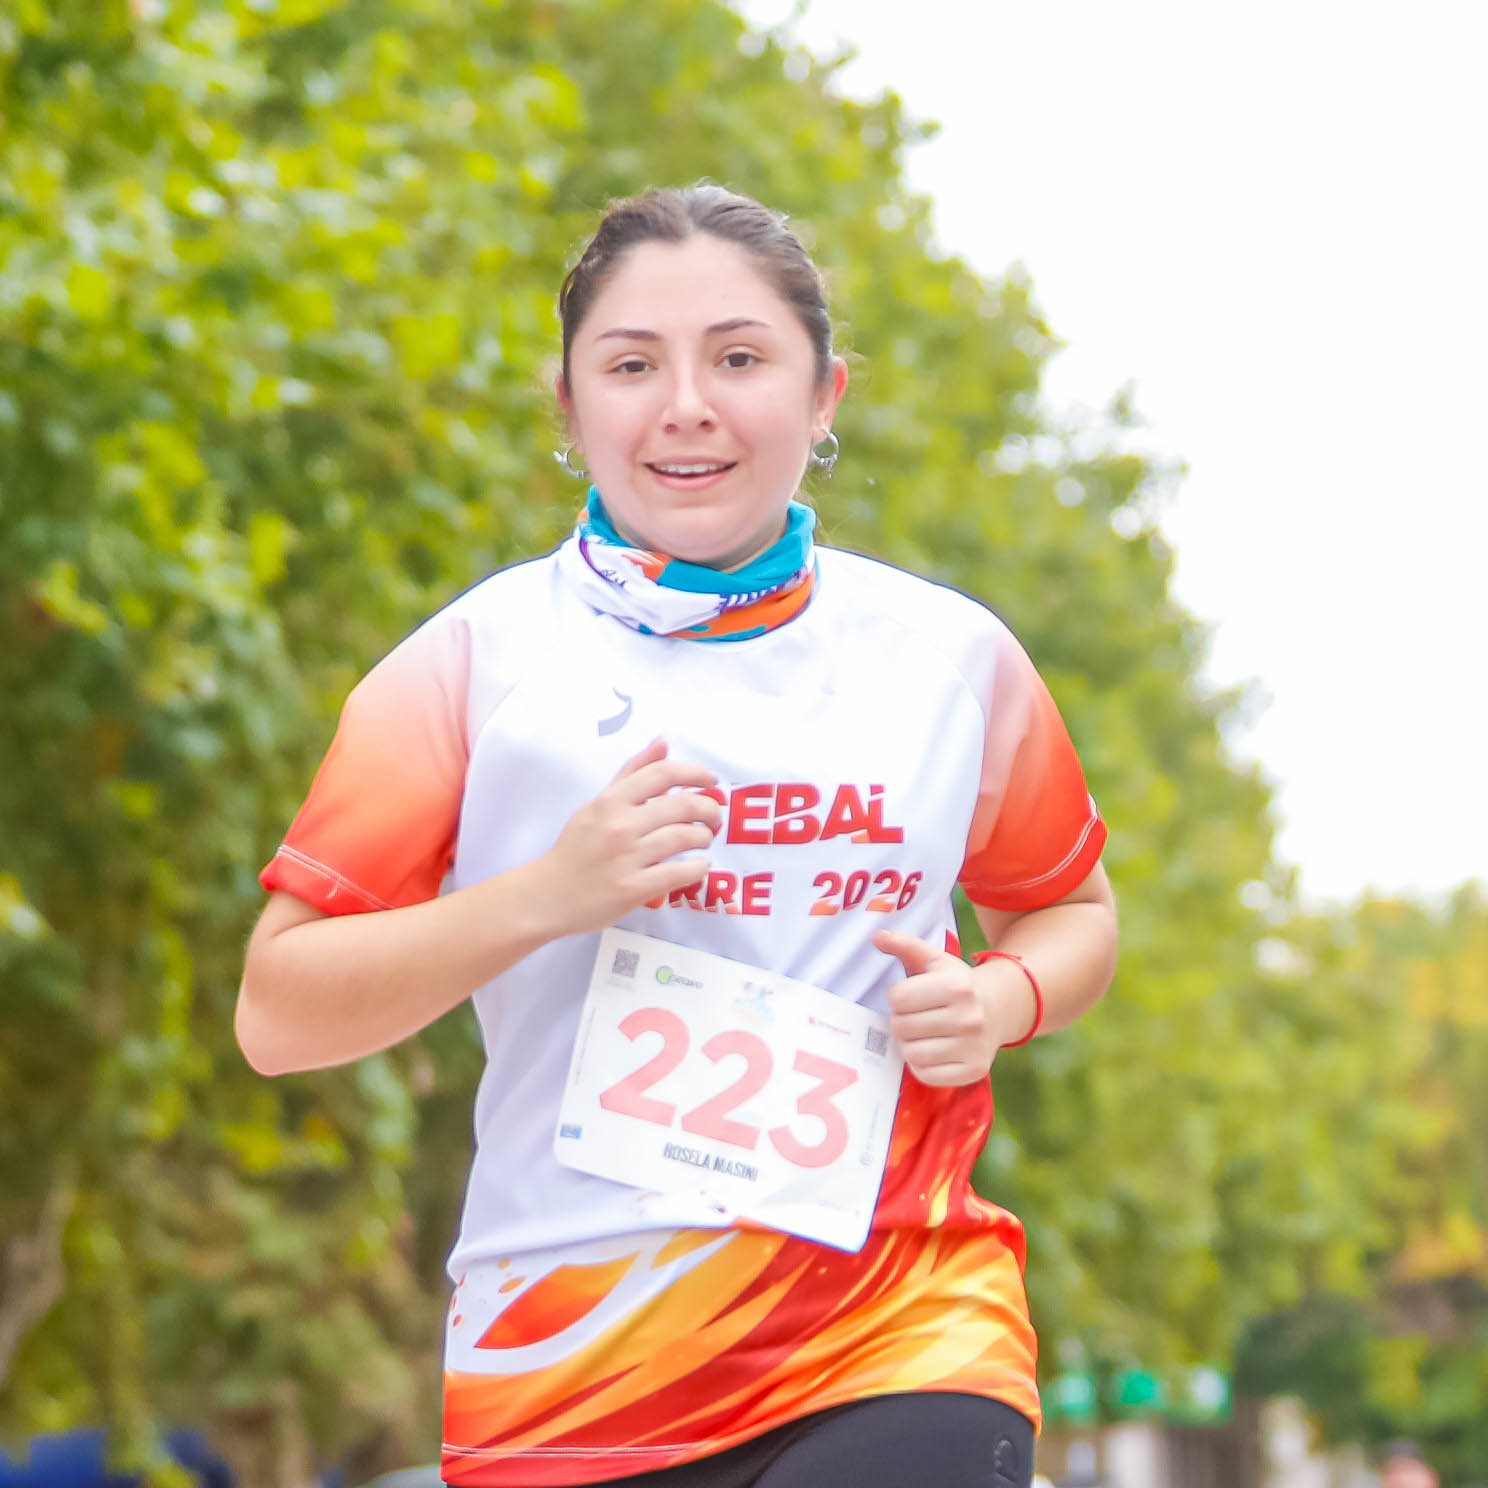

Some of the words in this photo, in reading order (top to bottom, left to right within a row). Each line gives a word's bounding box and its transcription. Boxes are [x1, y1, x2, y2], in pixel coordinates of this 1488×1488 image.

[644, 871, 775, 915] RRE
[809, 869, 923, 915] 2026
[599, 1007, 859, 1169] 223
